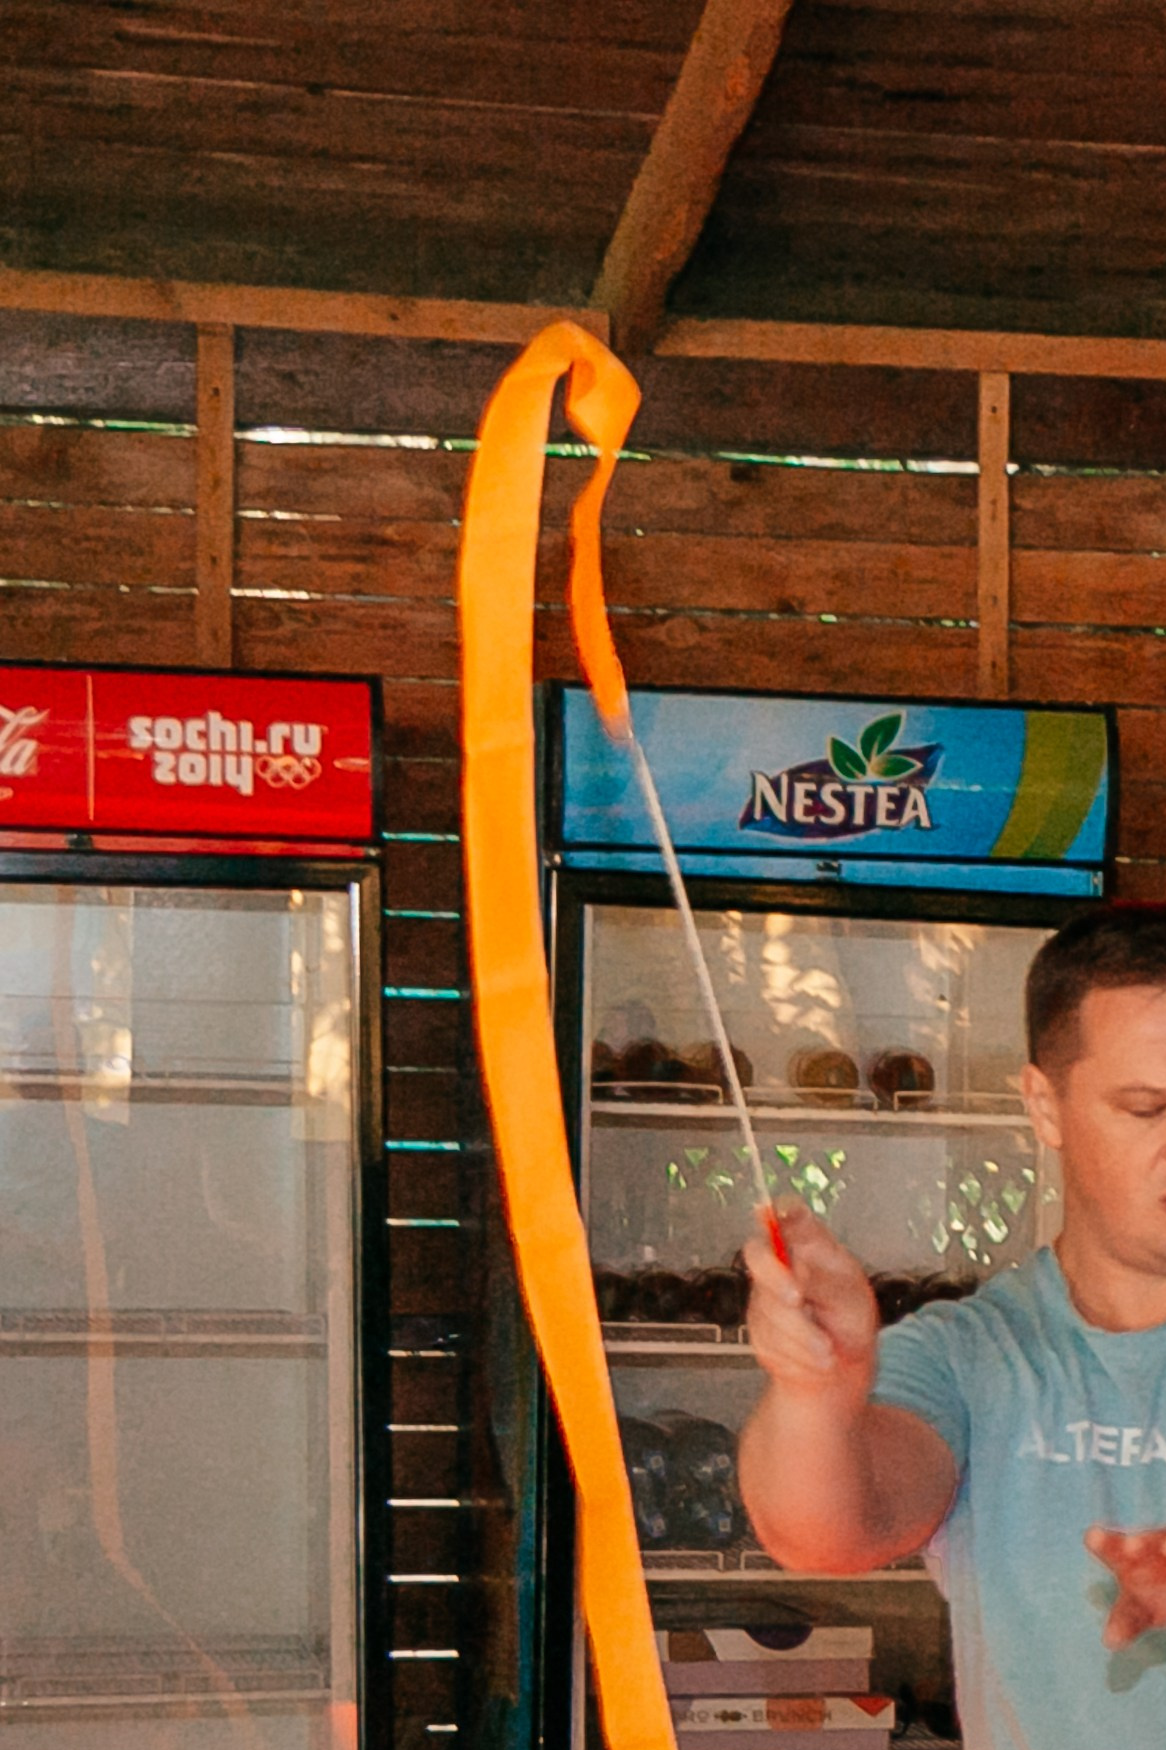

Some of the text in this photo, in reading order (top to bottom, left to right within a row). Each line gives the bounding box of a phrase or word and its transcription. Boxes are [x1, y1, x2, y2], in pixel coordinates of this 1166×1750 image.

[128, 710, 323, 756] sochi.ru
[152, 752, 254, 797] 2014
[753, 770, 933, 829] NESTEA
